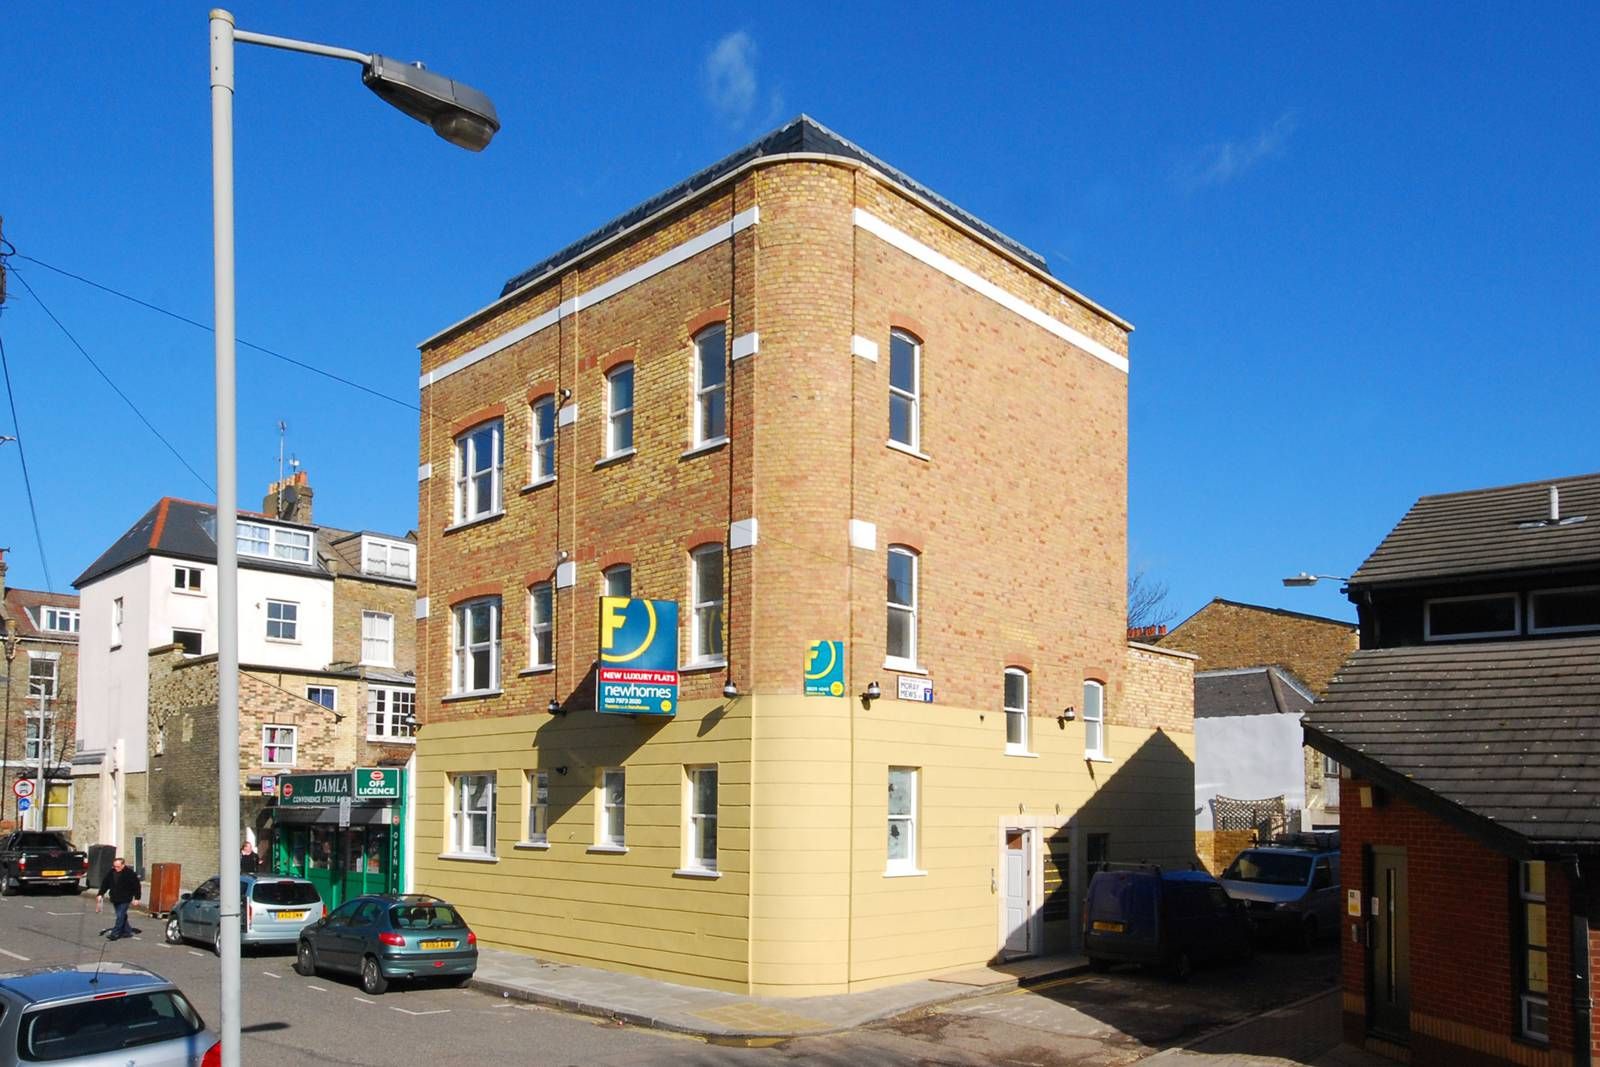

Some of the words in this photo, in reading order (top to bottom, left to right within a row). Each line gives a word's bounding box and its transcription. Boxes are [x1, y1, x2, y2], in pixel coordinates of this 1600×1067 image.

[623, 673, 653, 681] LUXURY
[653, 674, 676, 682] FLATS
[604, 683, 672, 699] newhomes
[314, 778, 348, 793] DAMLA
[368, 780, 386, 788] OFF
[359, 787, 395, 795] LICENCE
